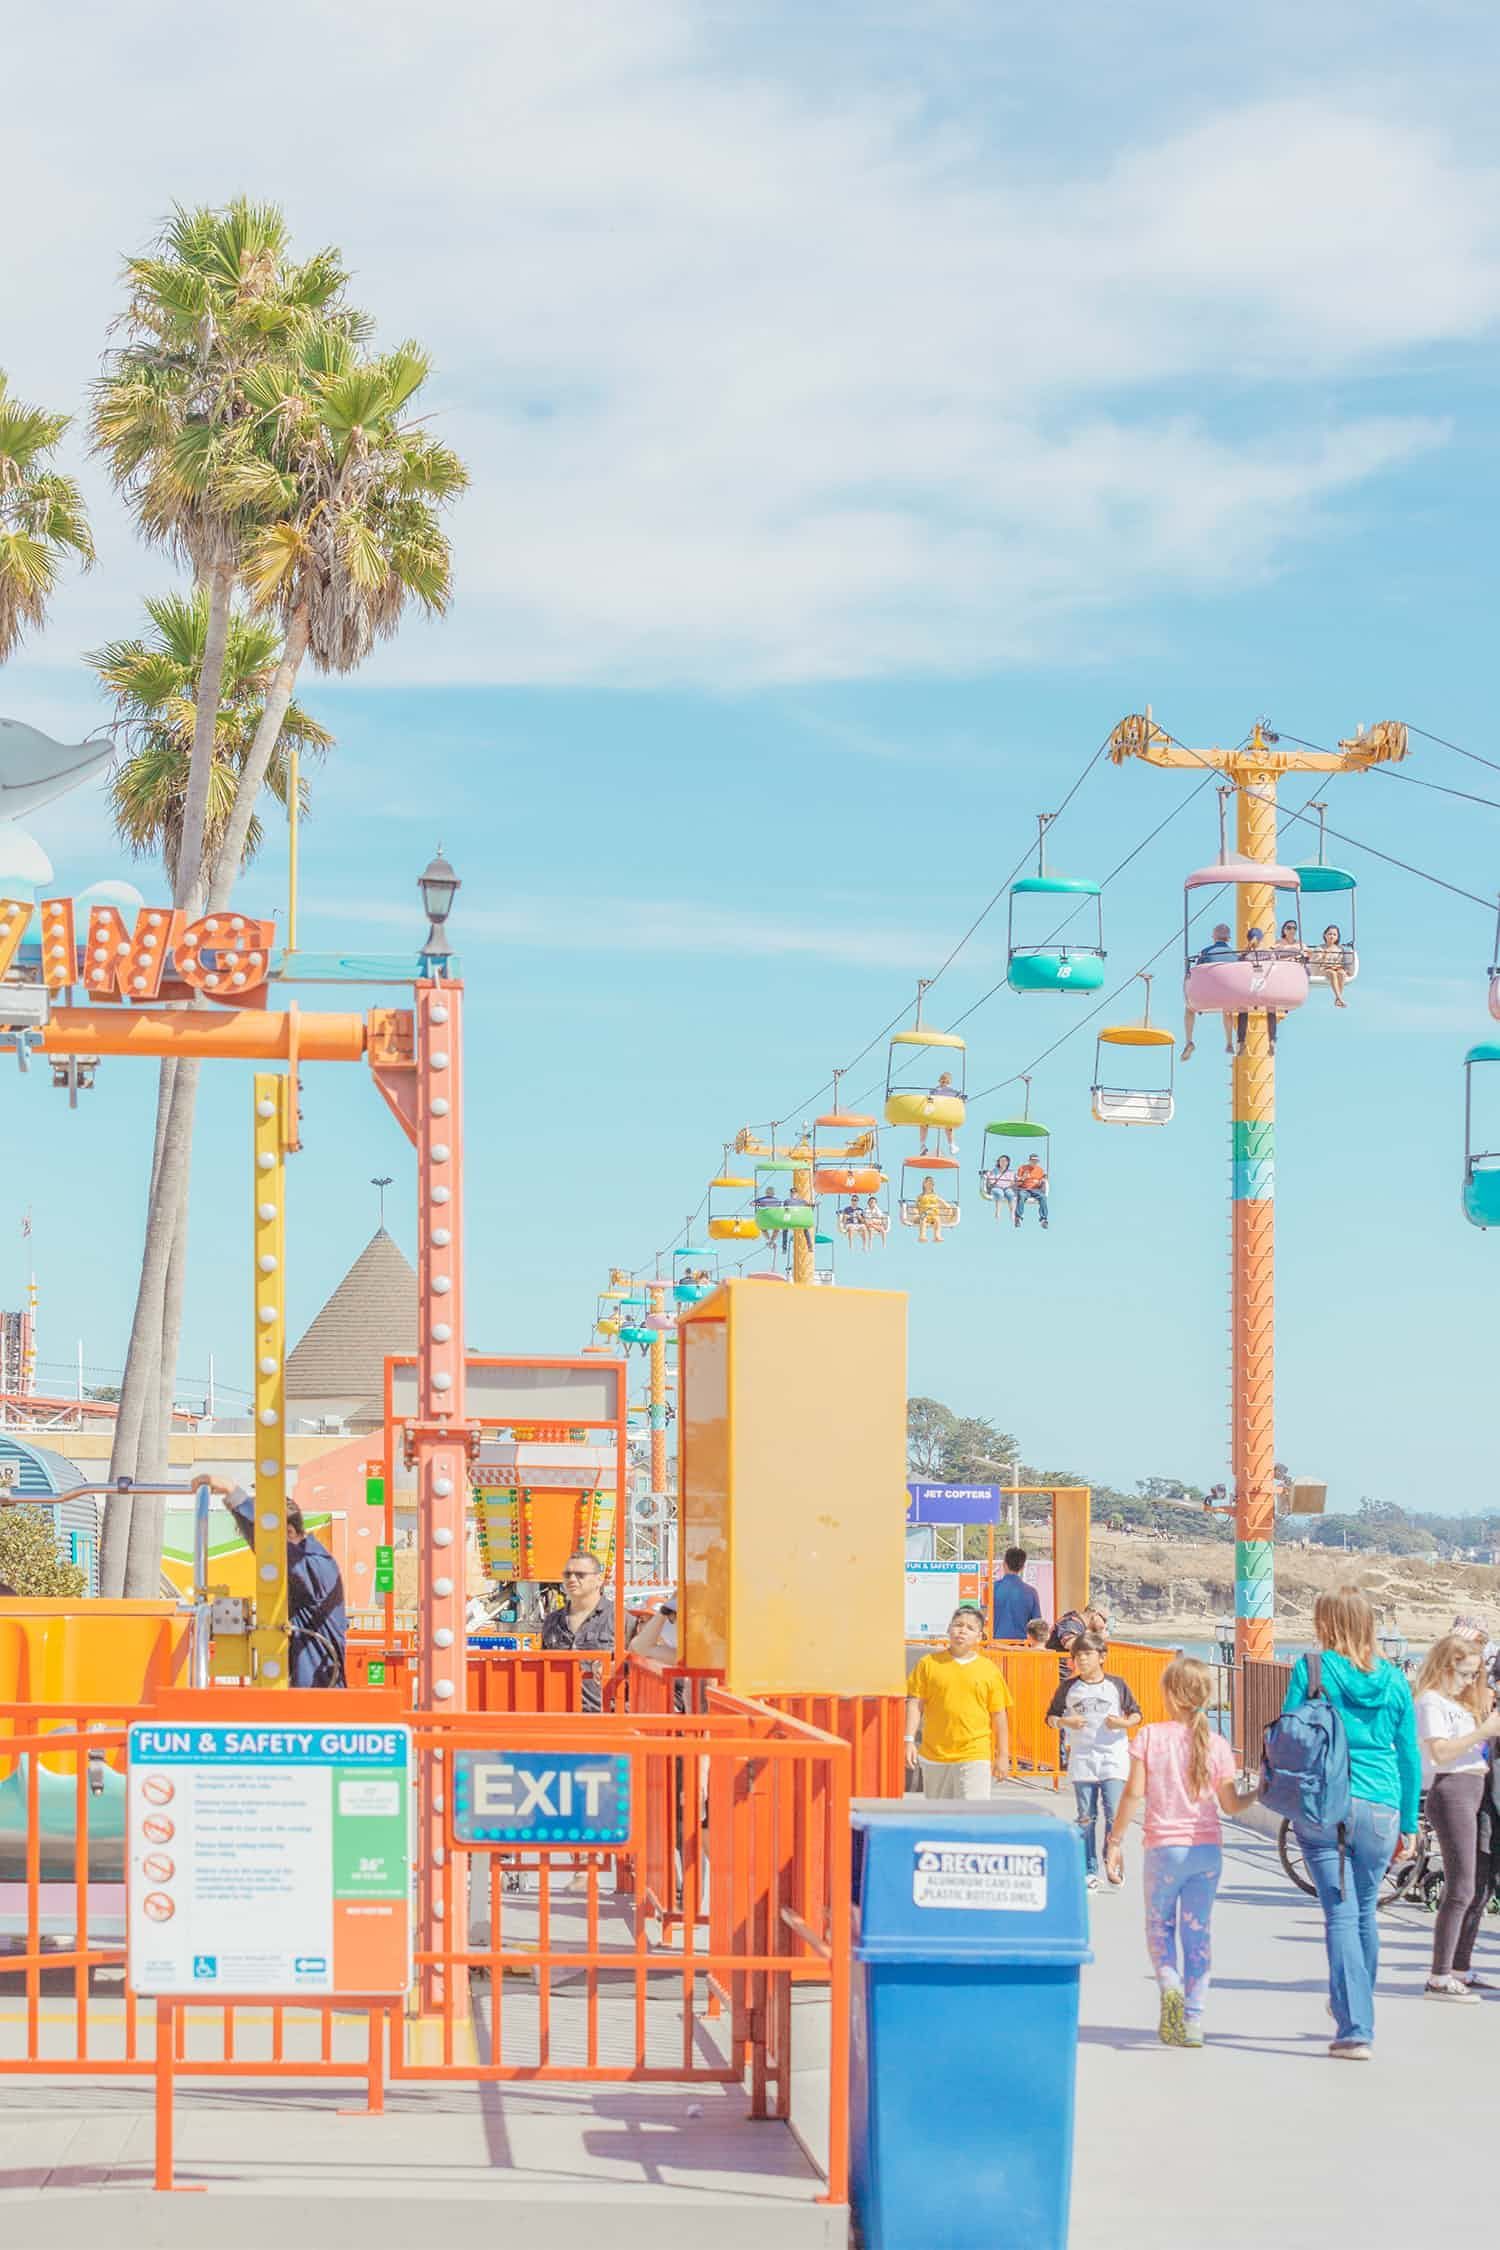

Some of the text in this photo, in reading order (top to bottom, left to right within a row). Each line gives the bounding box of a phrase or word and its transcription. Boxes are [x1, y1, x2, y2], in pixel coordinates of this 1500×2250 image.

[923, 1489, 992, 1499] JET COPTERS
[956, 1562, 977, 1570] GUIDE
[139, 1732, 397, 1755] FUN & SAFETY GUIDE
[474, 1764, 612, 1817] EXIT
[940, 1853, 1042, 1876] RECYCLING
